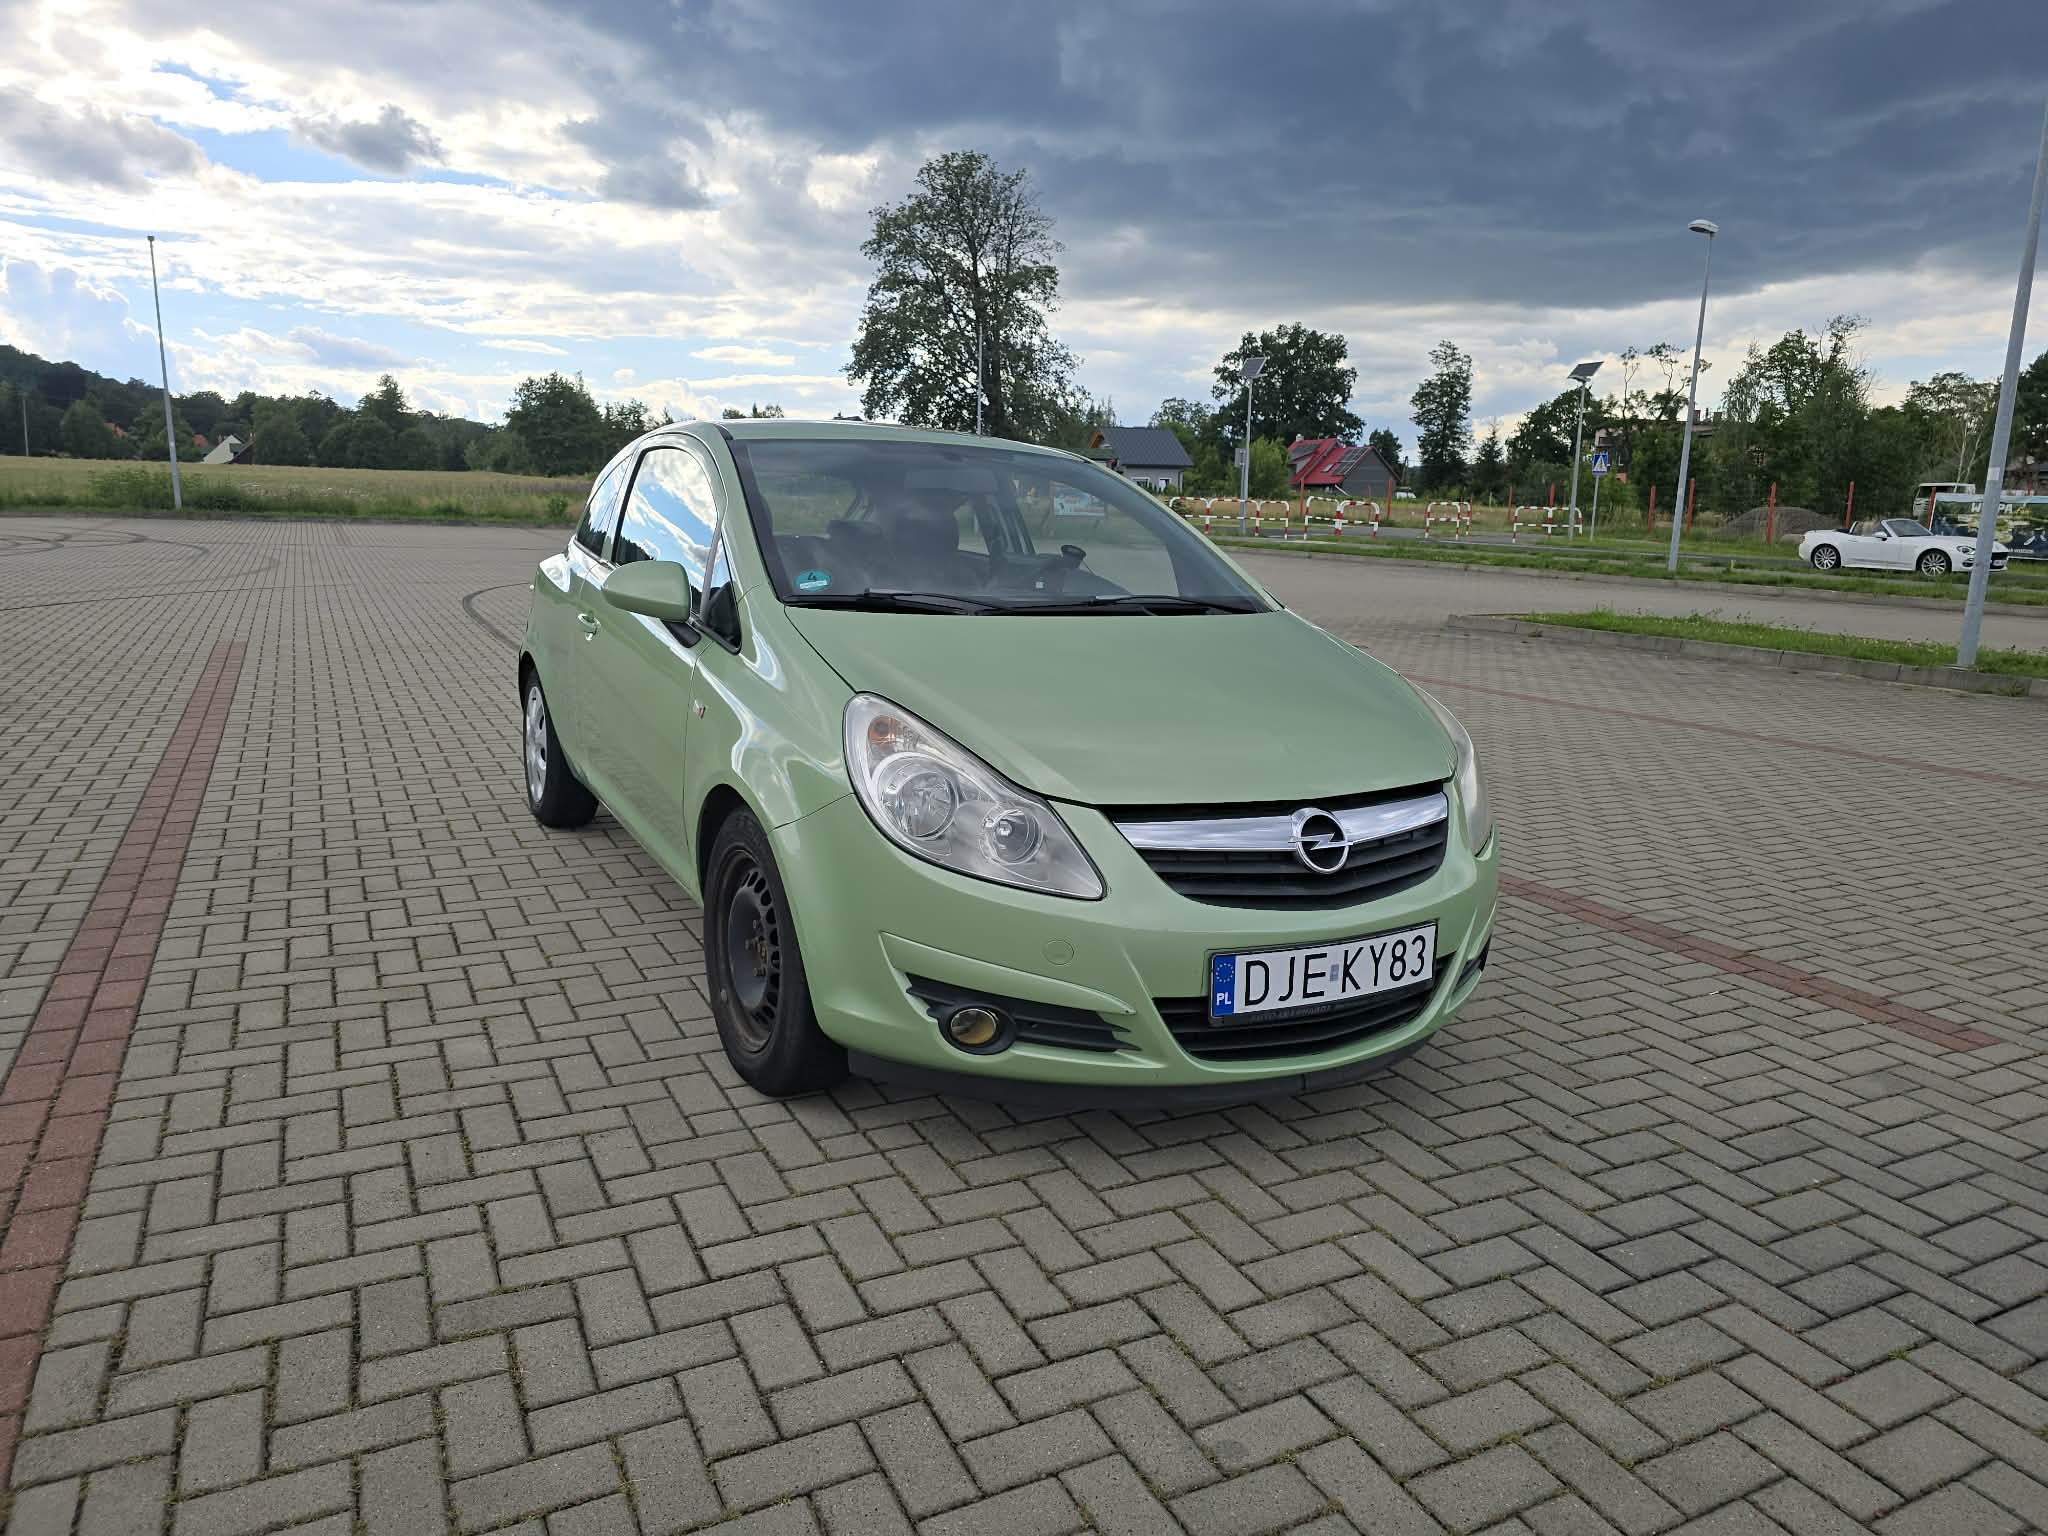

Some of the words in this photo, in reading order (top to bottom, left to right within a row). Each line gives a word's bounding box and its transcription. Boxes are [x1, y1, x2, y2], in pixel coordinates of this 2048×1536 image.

[1971, 503, 2013, 513] WPA
[1245, 953, 1327, 1006] DJE
[1341, 935, 1426, 993] KY83
[1216, 991, 1232, 1006] PL
